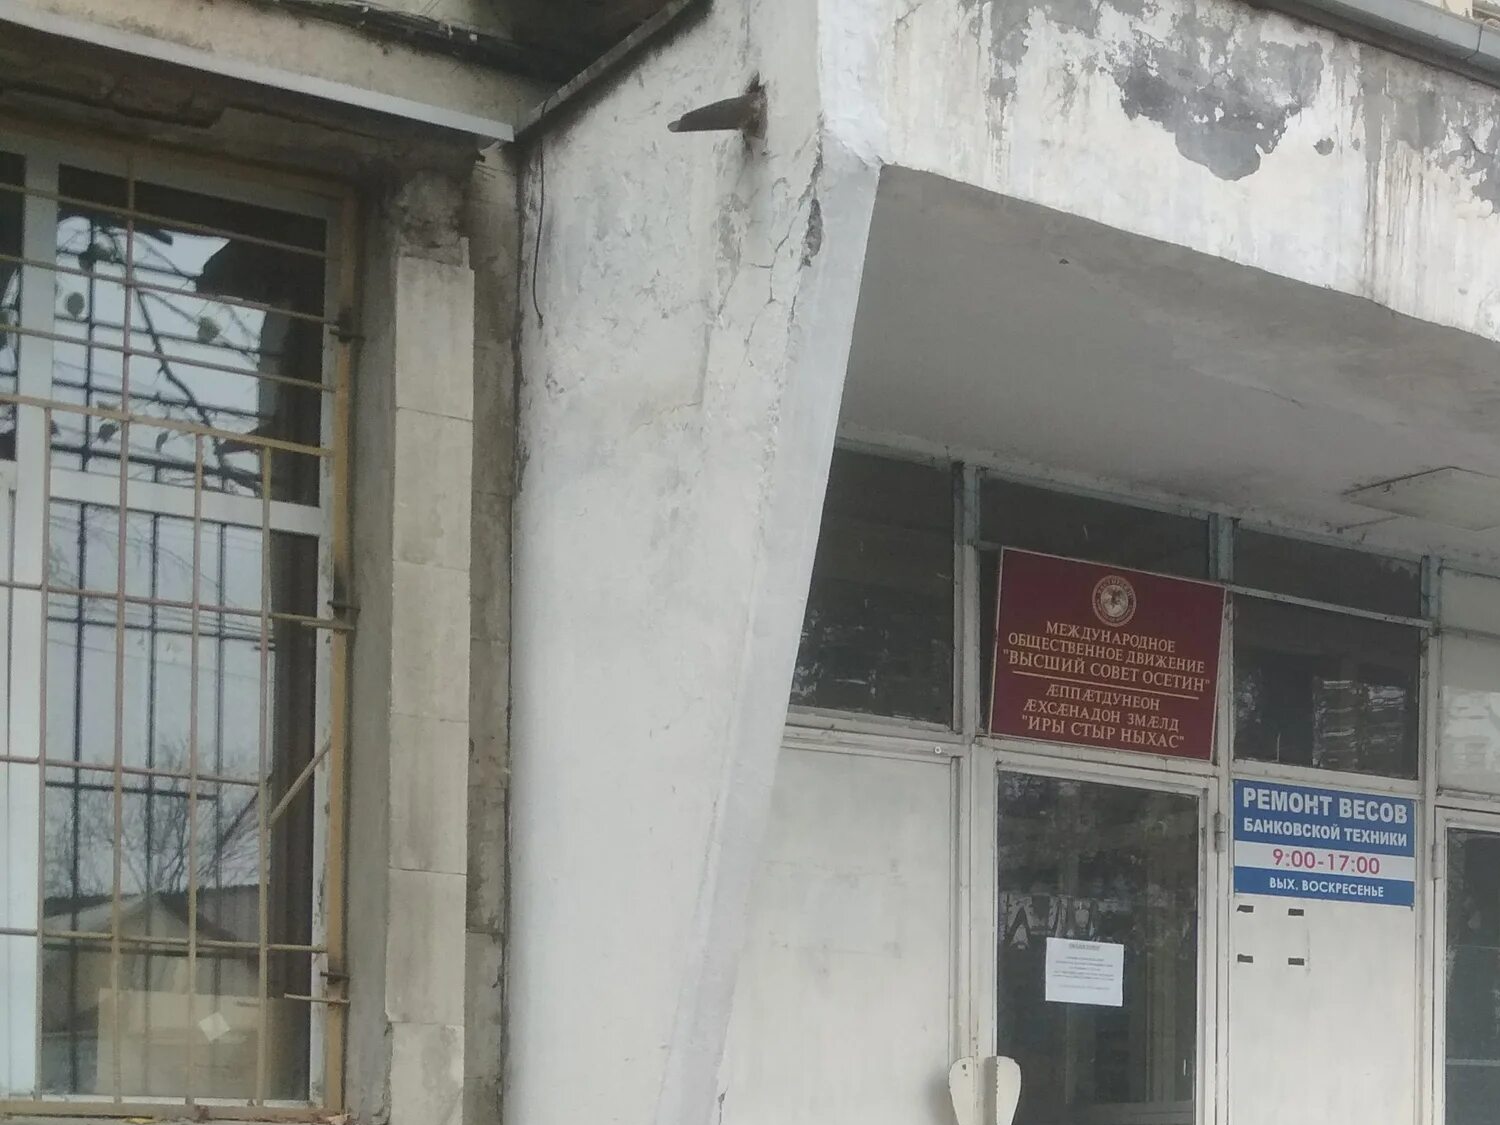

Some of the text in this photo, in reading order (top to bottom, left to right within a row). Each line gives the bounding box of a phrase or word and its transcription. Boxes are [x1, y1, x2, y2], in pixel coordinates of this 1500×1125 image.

[1008, 632, 1205, 673] ОБЩЕСТВЕННОЕ ДВИЖЕНИЕ
[1046, 621, 1176, 653] МЕЖДУНАРОДНОЕ
[1003, 649, 1210, 692] "ВЫСШИЙ СОВЕТ ОСЕТИН"
[1070, 722, 1115, 740] СТЫР
[1243, 787, 1407, 824] РЕМОНТ ВЕСОВ
[1243, 817, 1407, 847] БАНКОВСКОЙ ТЕХНИКИ
[1273, 848, 1380, 874] 9:00-17:00
[1269, 877, 1384, 898] ВЫХ. ВОСКРЕСЕНЬЕ
